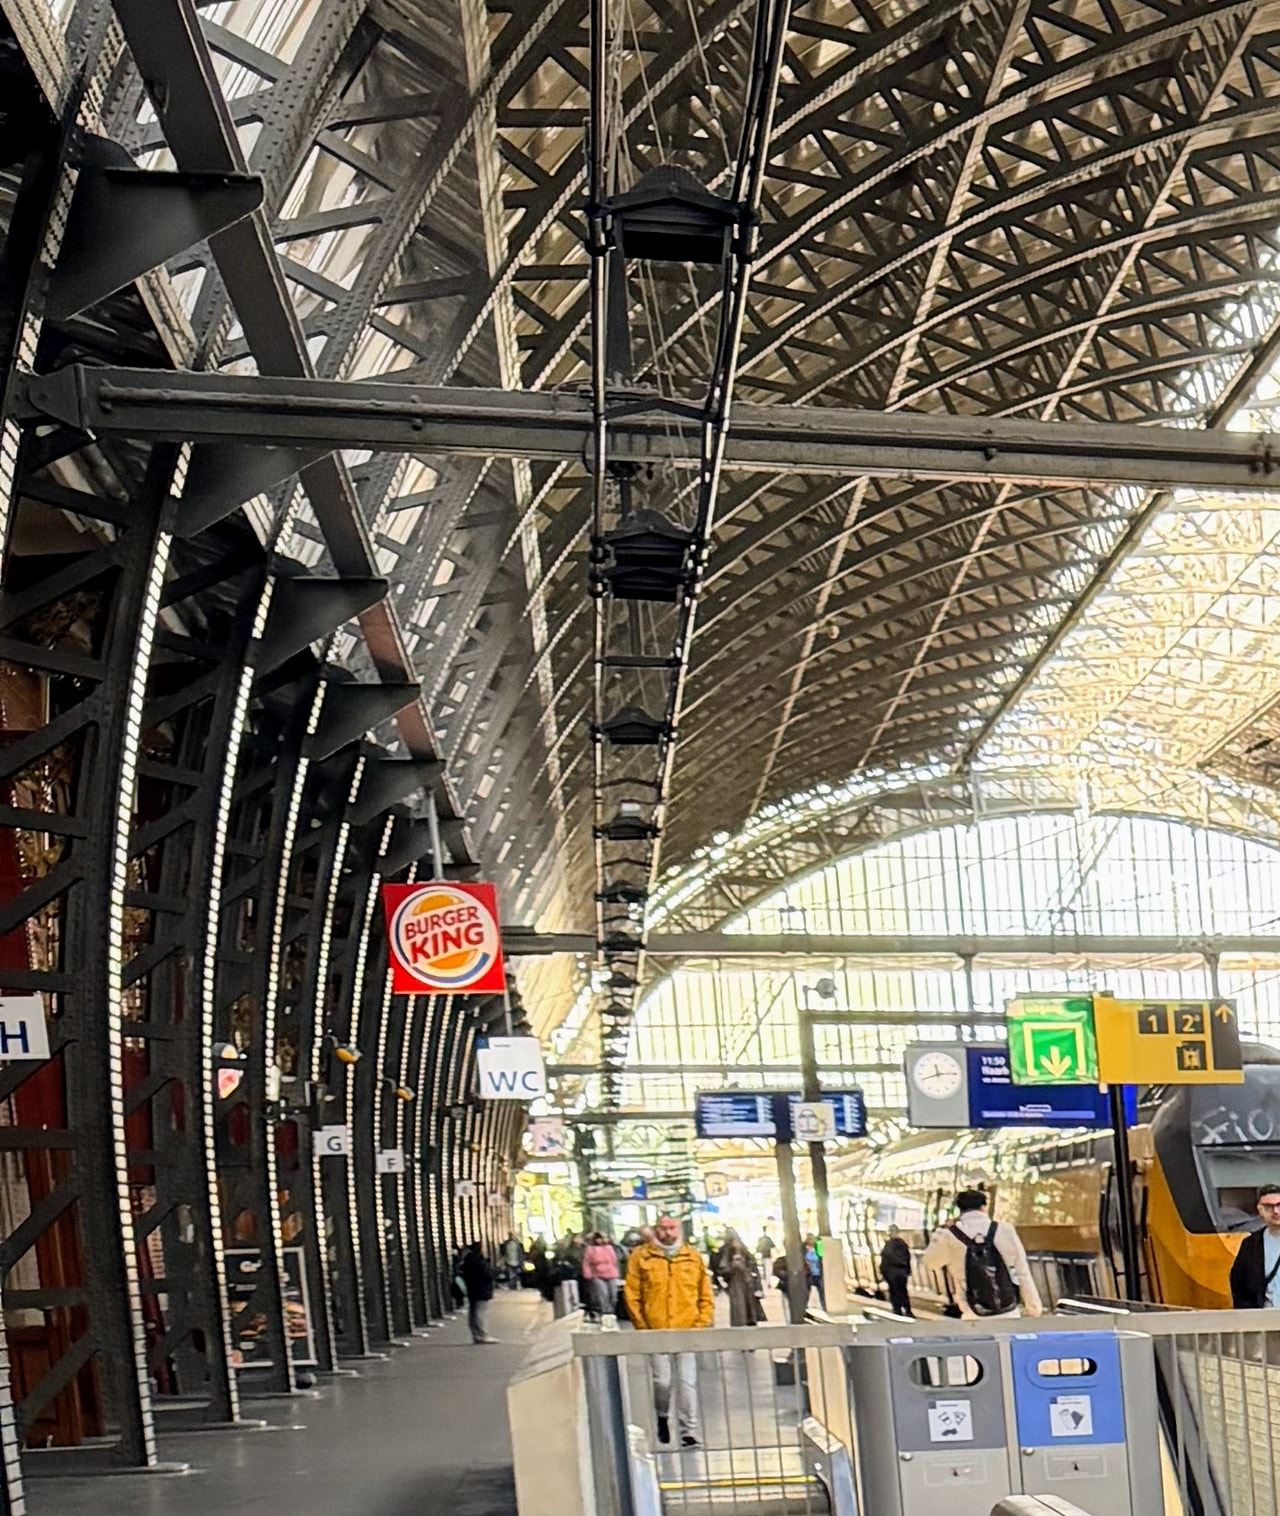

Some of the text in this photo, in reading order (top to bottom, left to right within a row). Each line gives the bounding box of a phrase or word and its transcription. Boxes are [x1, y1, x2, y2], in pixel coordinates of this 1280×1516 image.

[405, 906, 480, 940] BURGER
[410, 922, 484, 964] KING
[1147, 1014, 1158, 1032] 1
[0, 1020, 29, 1054] H
[487, 1070, 539, 1092] WC
[326, 1136, 342, 1152] G
[386, 1157, 397, 1170] F
